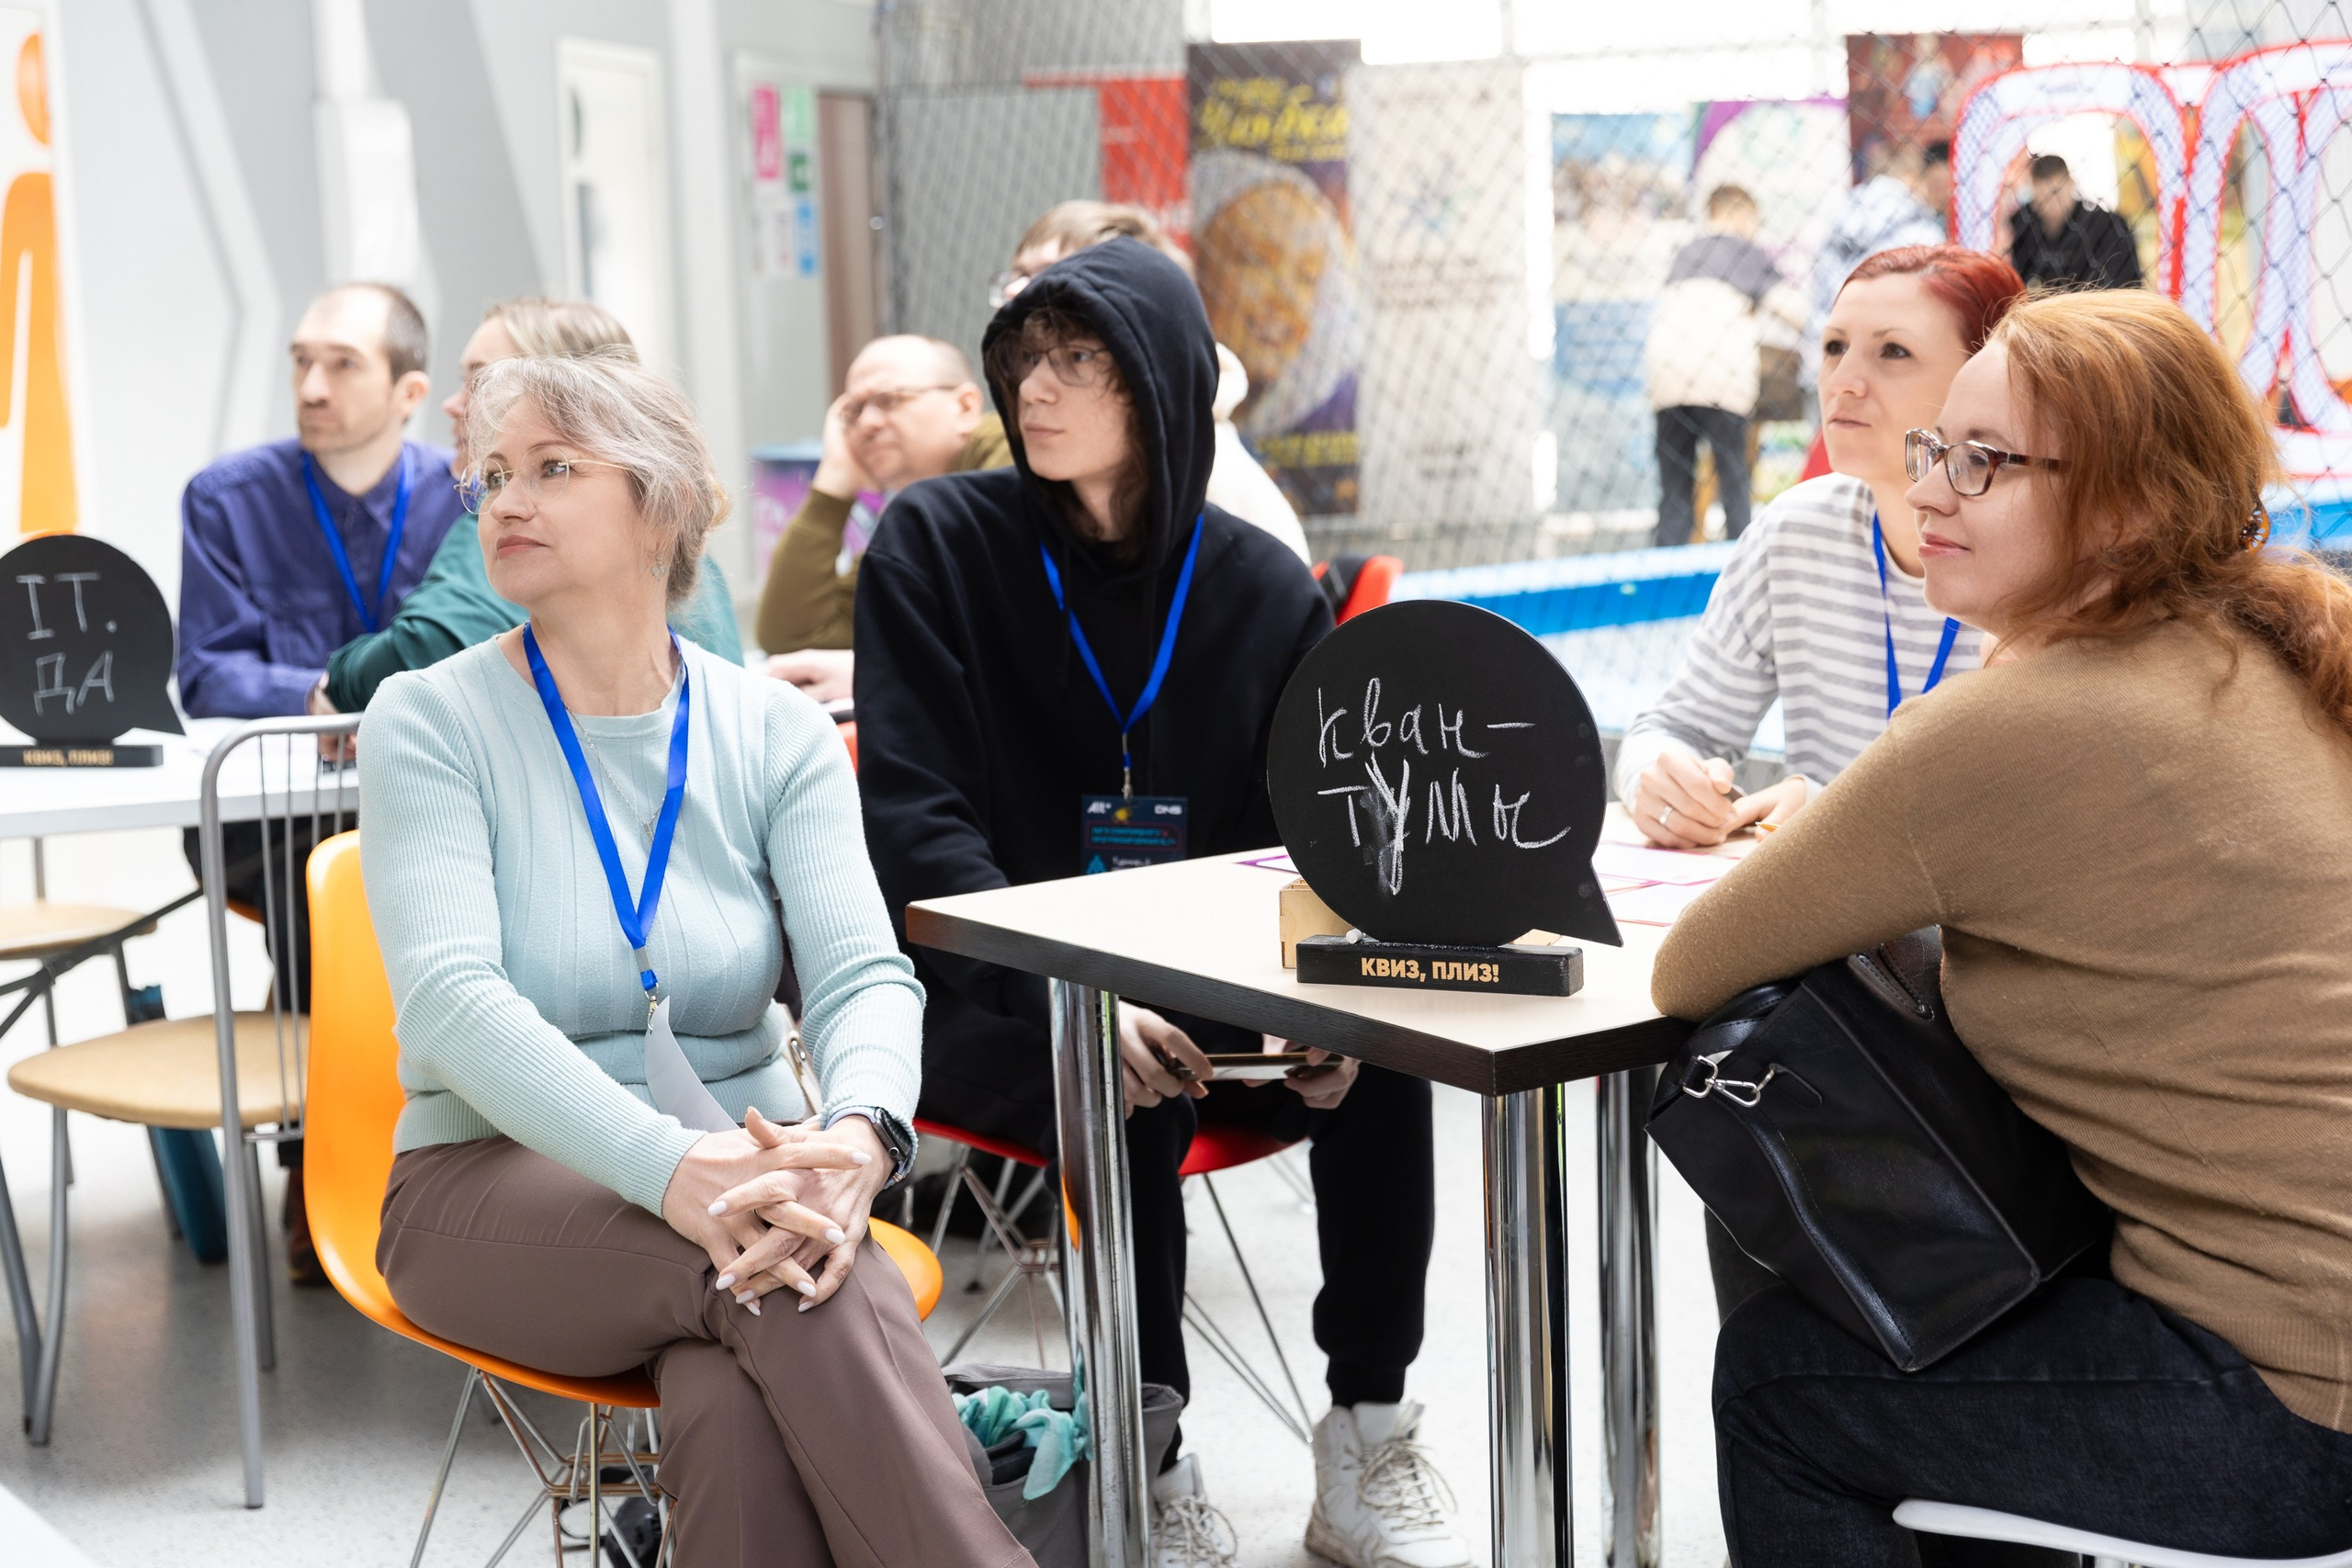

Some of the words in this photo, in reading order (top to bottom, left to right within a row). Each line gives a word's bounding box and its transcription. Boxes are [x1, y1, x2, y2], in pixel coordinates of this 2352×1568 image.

[33, 649, 115, 716] ДА
[1361, 957, 1426, 982] КВИЗ,
[1432, 961, 1499, 984] ПЛИЗ!
